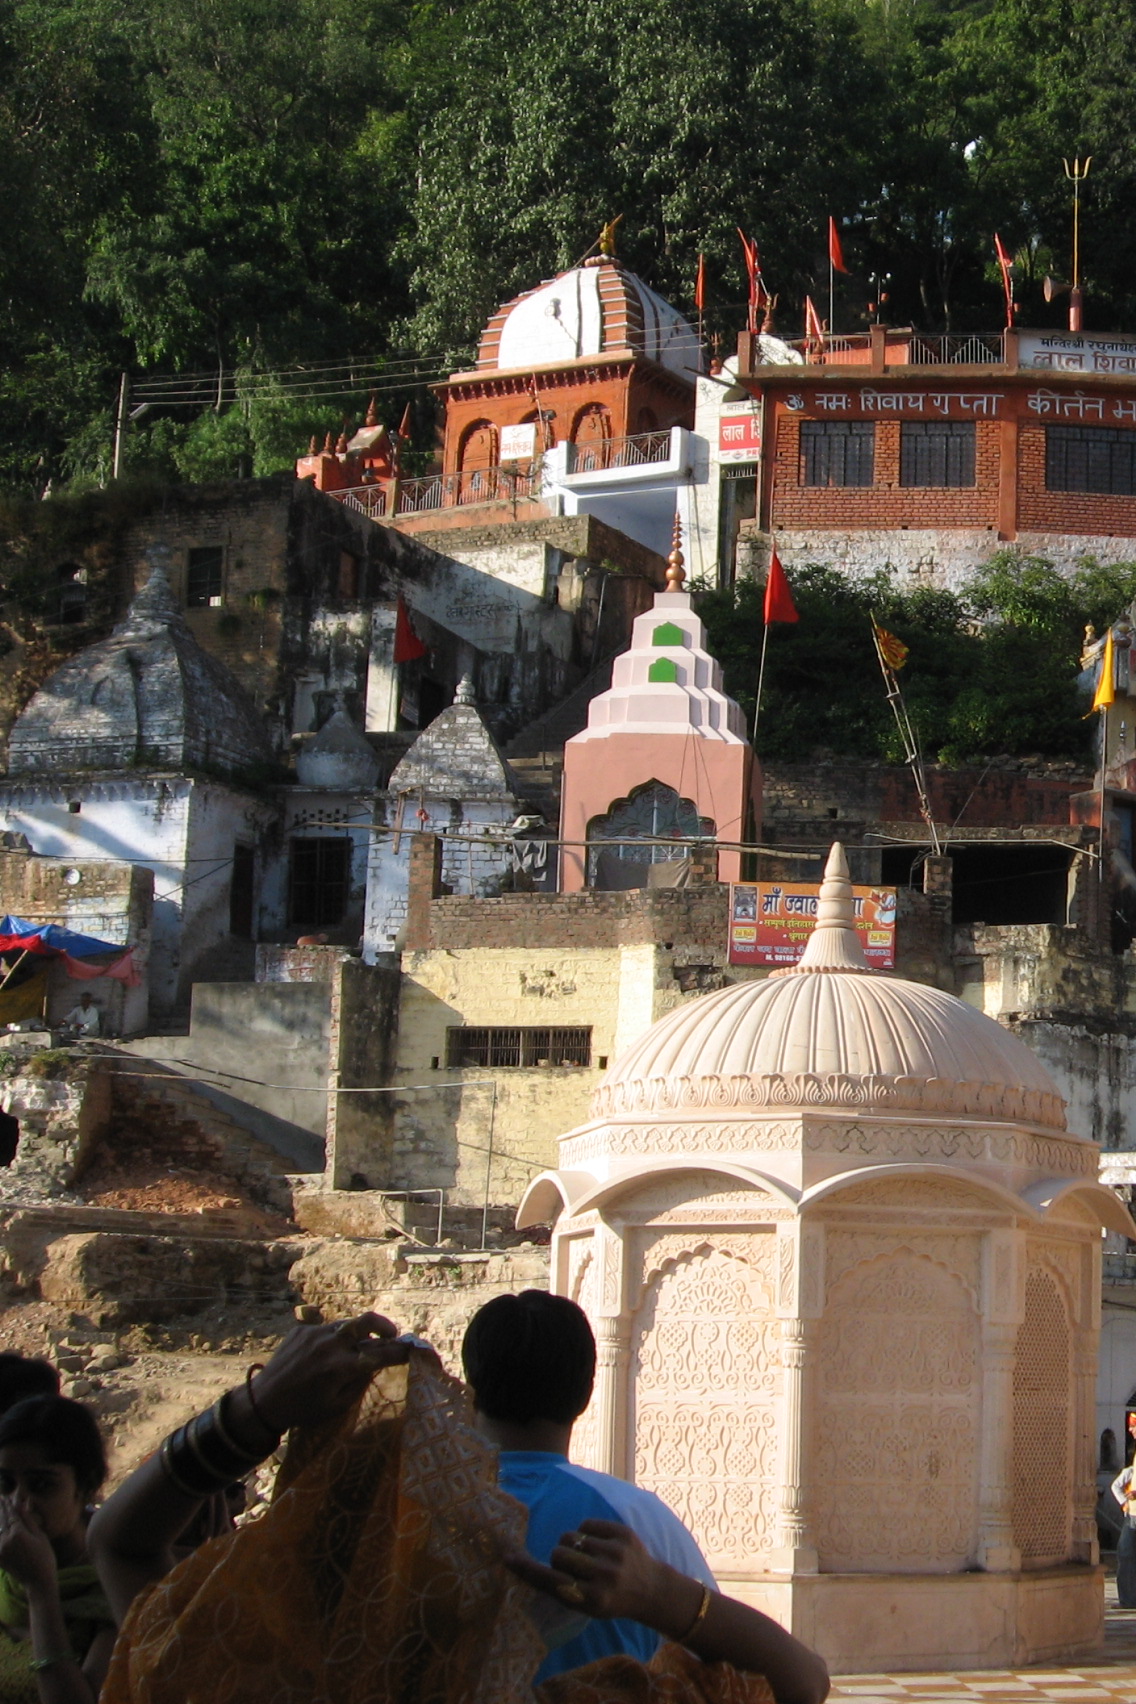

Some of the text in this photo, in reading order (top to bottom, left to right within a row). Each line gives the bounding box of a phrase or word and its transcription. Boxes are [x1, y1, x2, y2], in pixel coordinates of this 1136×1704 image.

[1033, 350, 1085, 370] लाल
[815, 393, 851, 411] नमः
[859, 387, 926, 411] शिवाय
[1027, 387, 1106, 419] कीर्तन
[722, 424, 746, 442] लाल
[762, 887, 782, 915] माँ
